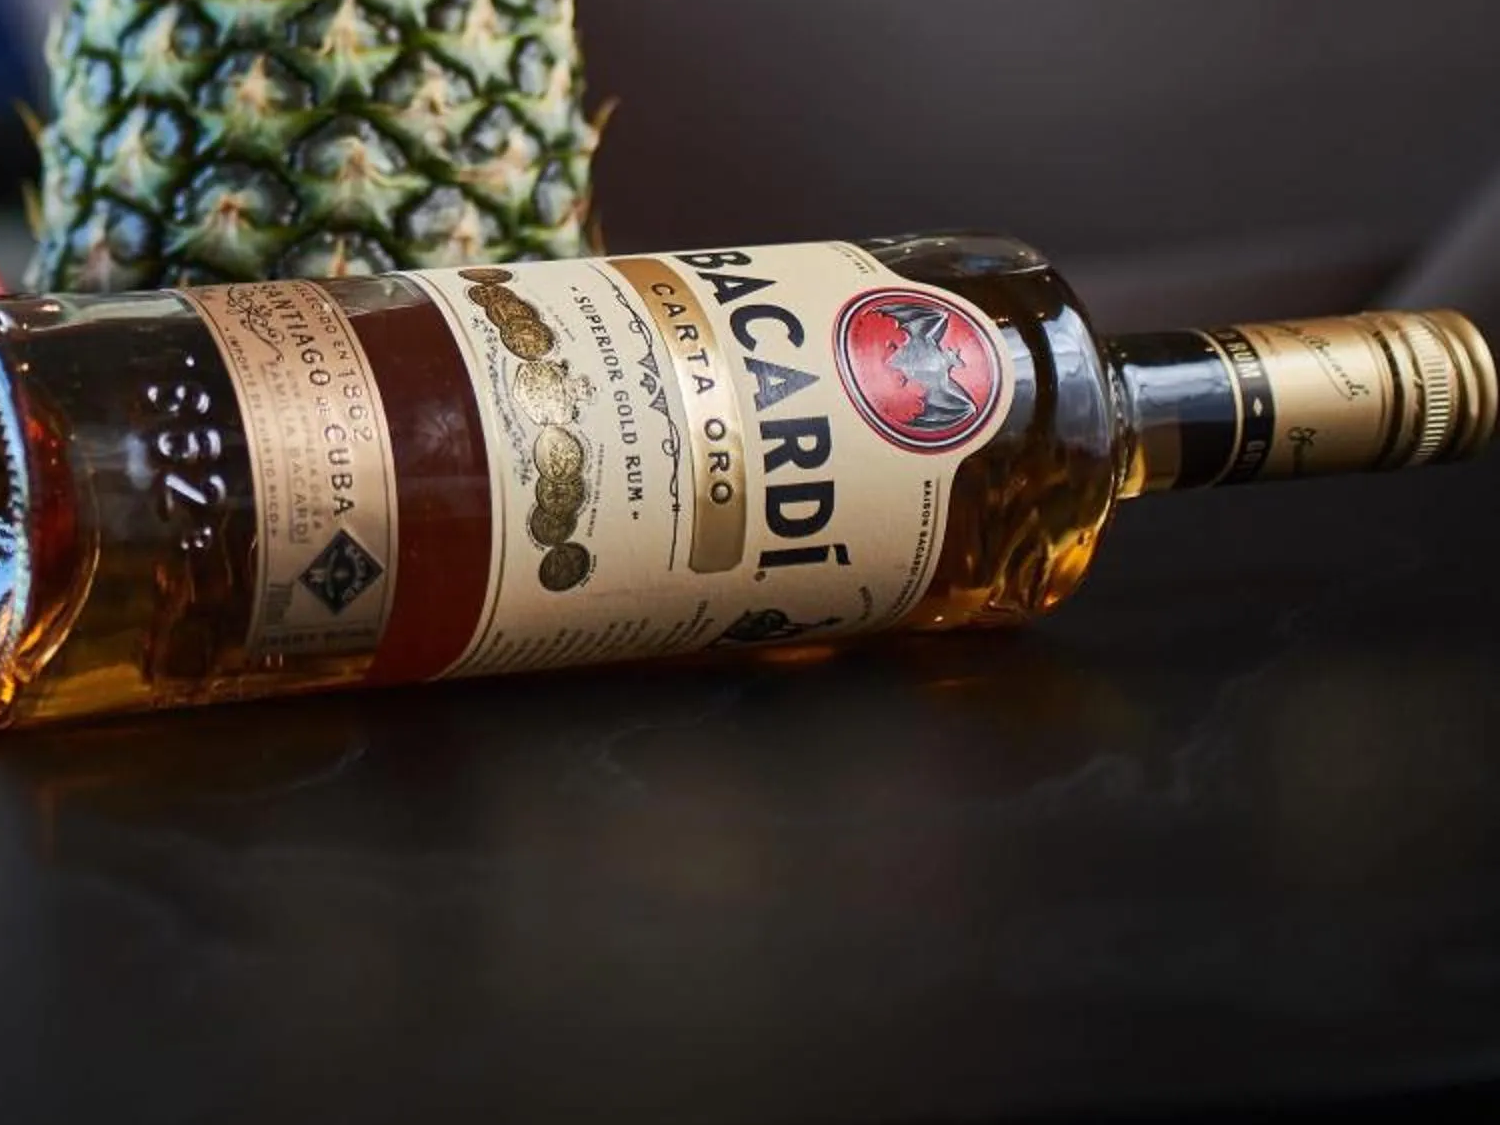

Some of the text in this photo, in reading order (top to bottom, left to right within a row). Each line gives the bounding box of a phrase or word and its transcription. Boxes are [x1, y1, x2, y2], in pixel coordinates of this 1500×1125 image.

[334, 342, 348, 360] EN
[1229, 342, 1262, 378] RUM
[260, 284, 331, 386] SANTIAGO
[324, 423, 355, 517] CUBA
[337, 368, 372, 442] 1862
[574, 295, 643, 502] SUPERIOR GOLD RUM
[652, 283, 732, 505] CARTA ORO
[673, 249, 851, 568] BACARDÍ
[268, 484, 279, 523] RICO
[922, 480, 932, 526] MAISON
